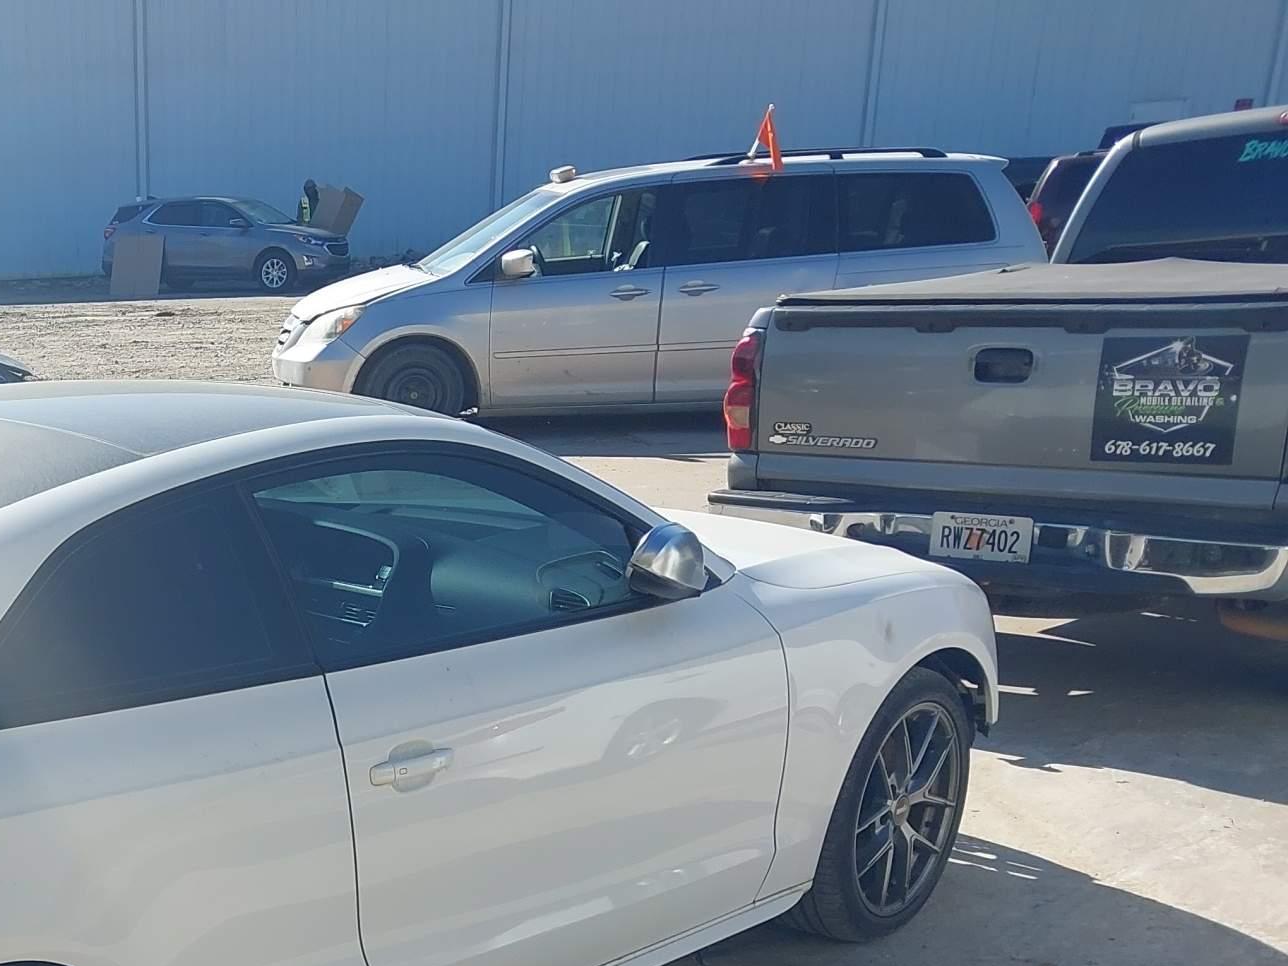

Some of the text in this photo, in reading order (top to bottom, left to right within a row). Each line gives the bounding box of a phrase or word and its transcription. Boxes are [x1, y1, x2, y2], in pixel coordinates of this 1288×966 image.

[1113, 379, 1220, 397] BRAVO
[1139, 396, 1170, 406] MOBILE
[1172, 396, 1214, 406] DETAILING
[1135, 415, 1197, 424] WASHING
[775, 422, 810, 432] CLASSIC
[787, 435, 875, 449] SILVERADO
[1105, 440, 1216, 457] 678-617-8667
[954, 516, 1008, 528] GEORGIA
